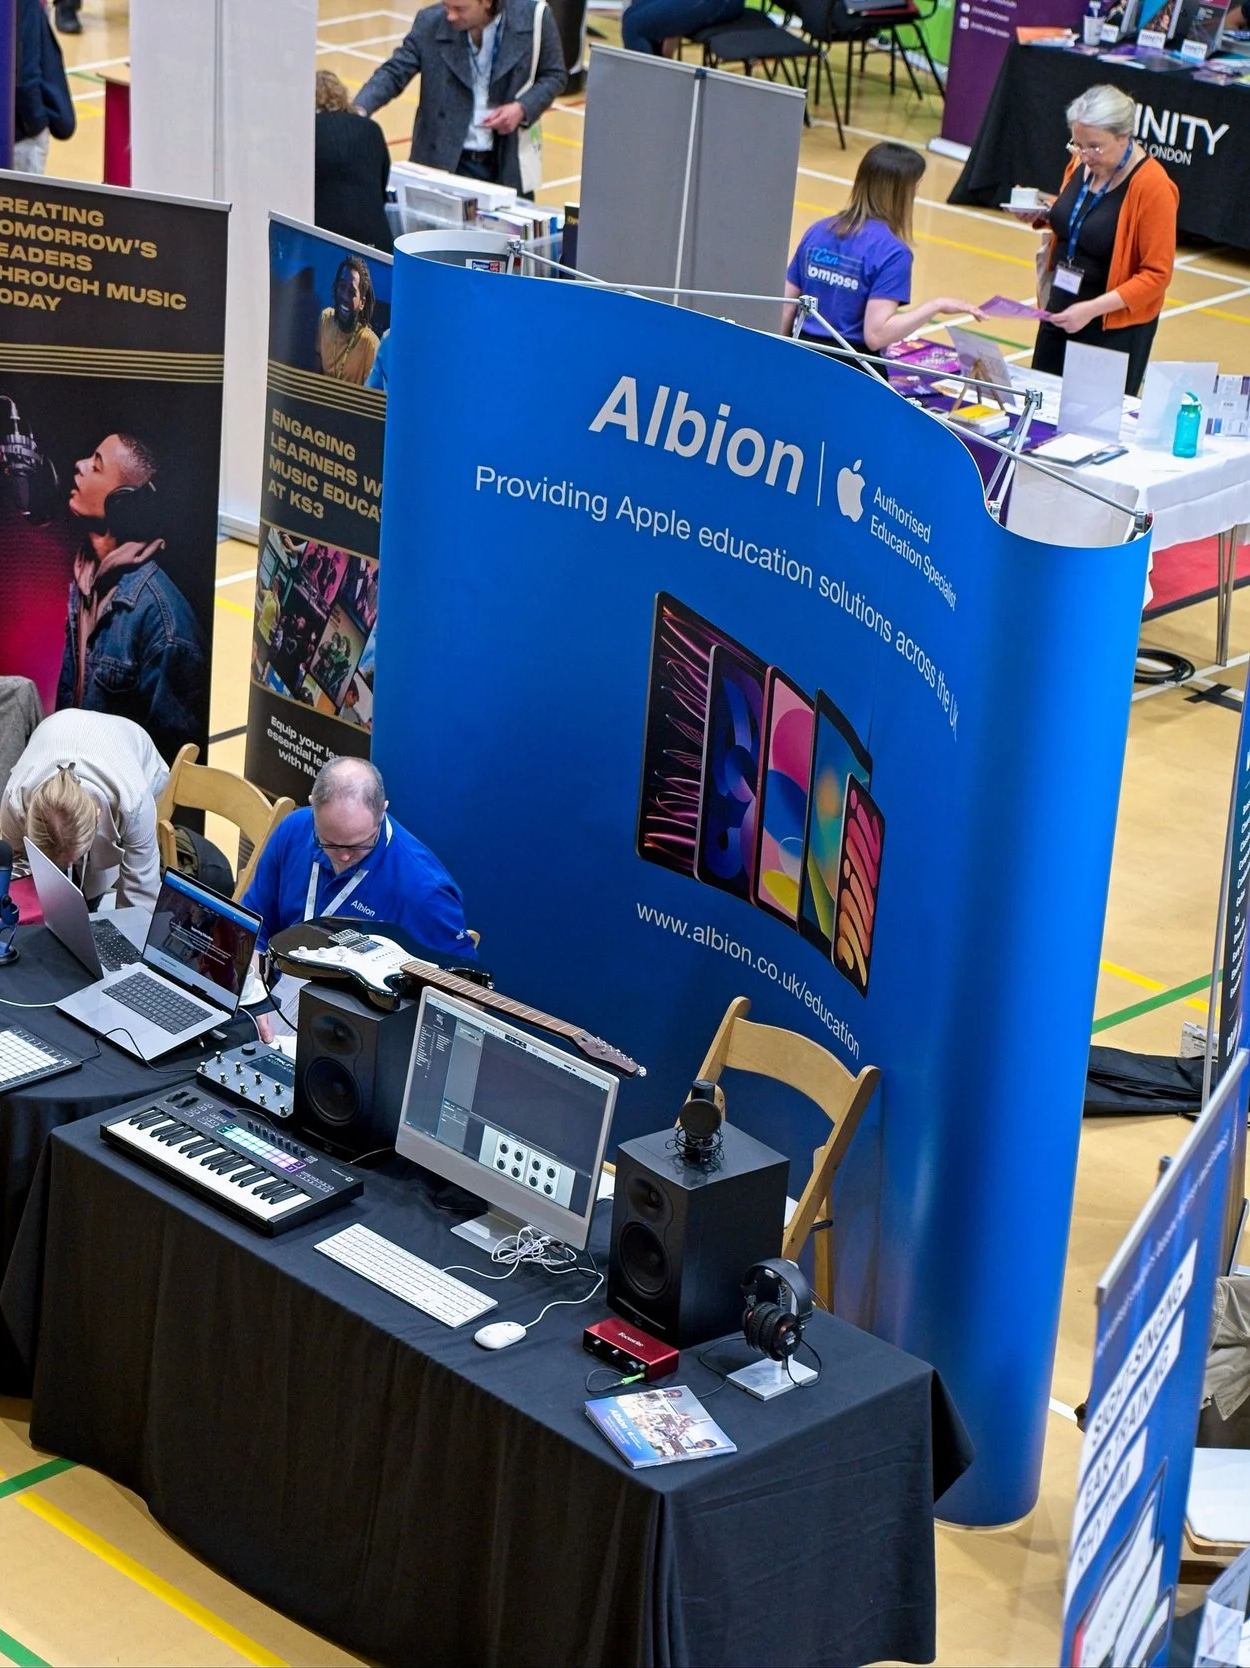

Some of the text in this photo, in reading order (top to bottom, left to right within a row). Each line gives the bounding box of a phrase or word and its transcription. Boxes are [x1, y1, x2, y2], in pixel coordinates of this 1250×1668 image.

[1134, 103, 1230, 155] INITY
[807, 264, 859, 290] ompose
[814, 249, 839, 265] Can
[106, 283, 187, 311] MUSIC
[270, 432, 358, 487] LEARNERS
[272, 408, 356, 461] ENGAGING
[588, 375, 804, 496] Albion
[268, 478, 325, 519] AT KS3
[269, 454, 382, 523] MUSIC EDUCA
[873, 486, 932, 544] Authorised
[475, 464, 609, 523] Providing
[615, 494, 691, 541] Apple
[698, 525, 814, 590] education
[818, 575, 892, 643] solutions
[895, 630, 936, 689] across
[937, 669, 950, 713] the
[870, 514, 957, 612] Education Specialist
[267, 728, 312, 762] essential
[271, 715, 297, 740] Equip
[299, 733, 324, 753] your
[278, 749, 301, 770] with
[351, 900, 376, 917] Albion
[636, 902, 860, 1061] www.albion.co.uk/education
